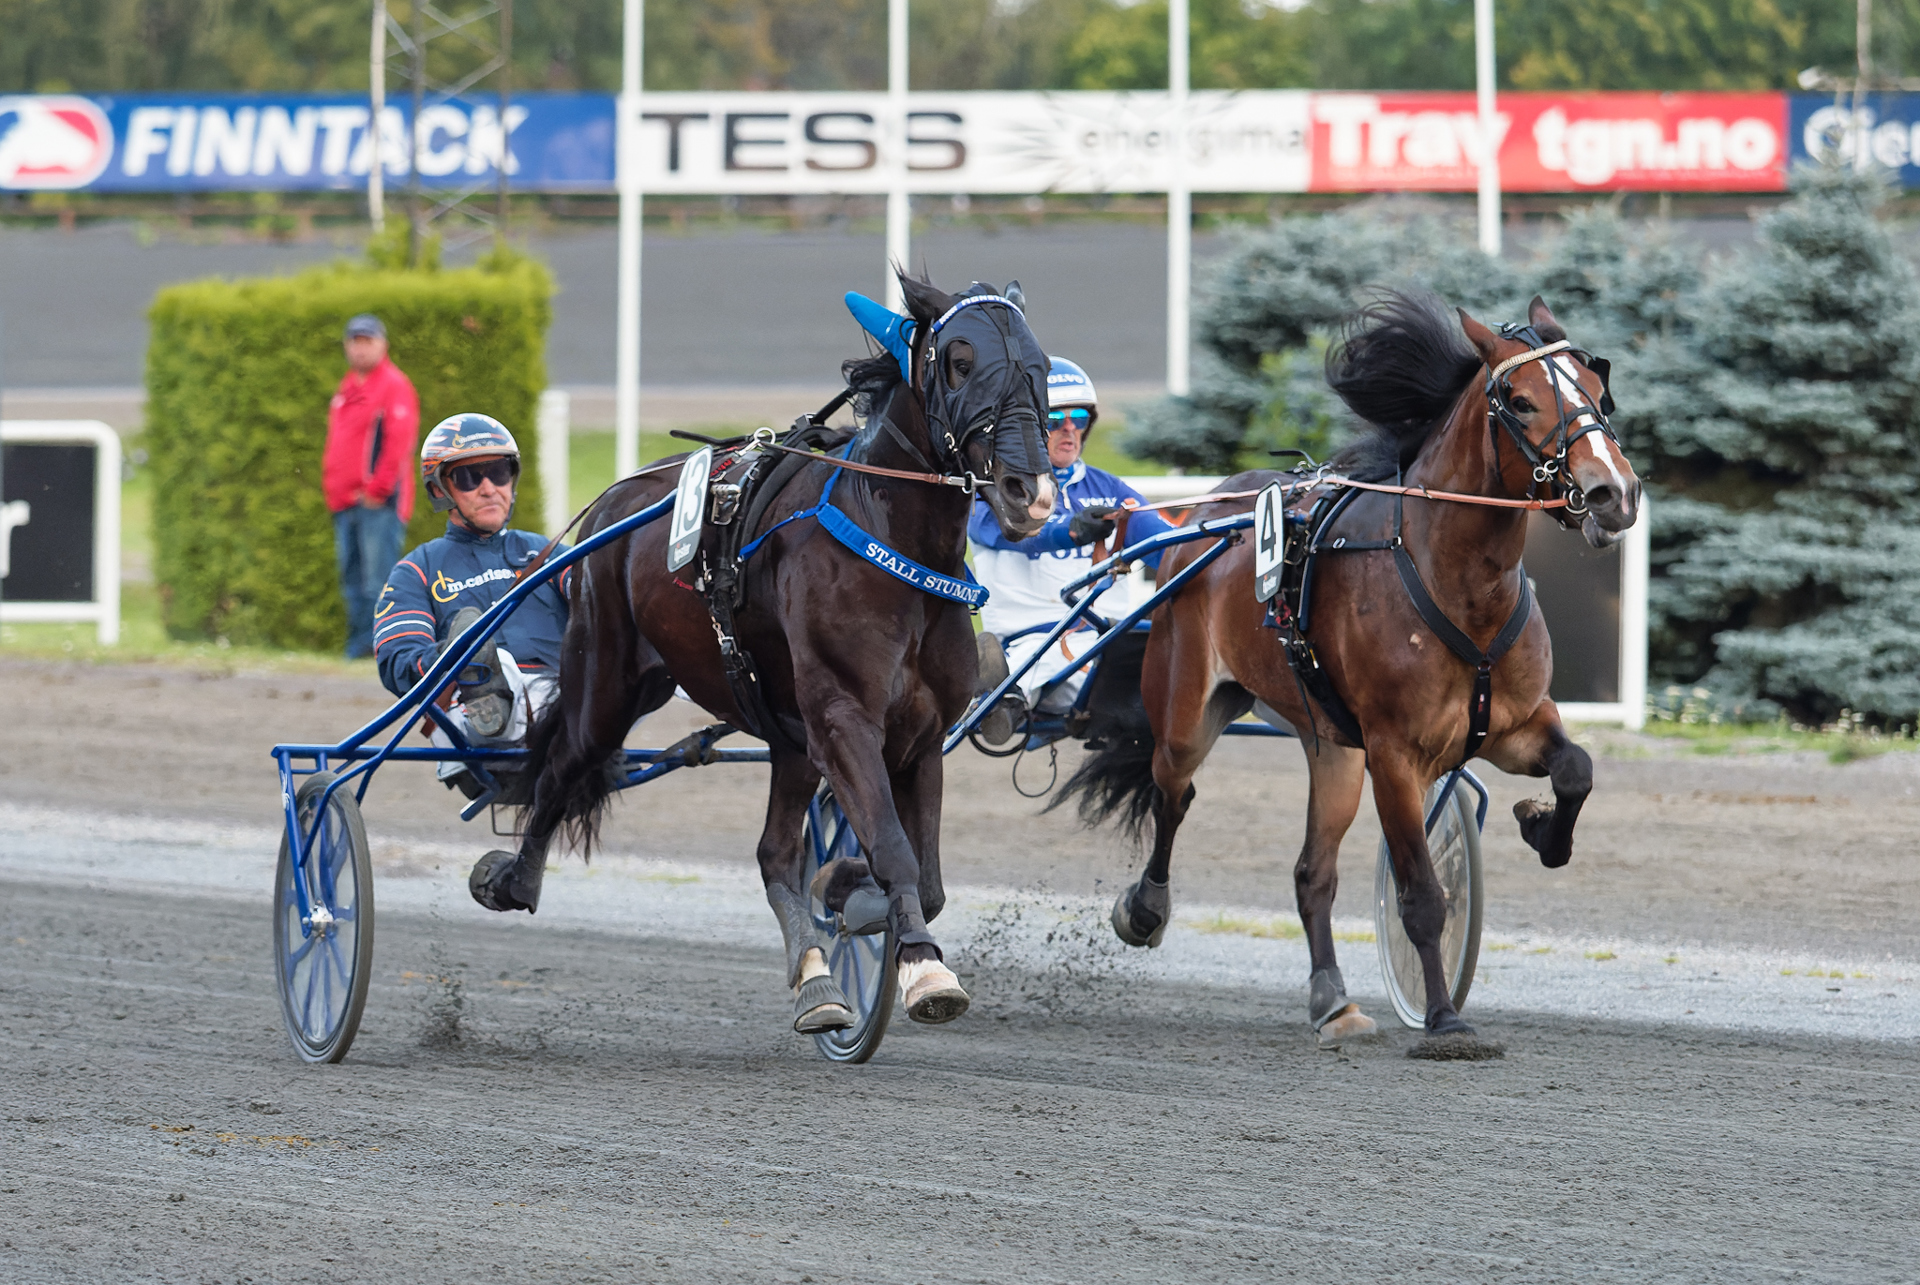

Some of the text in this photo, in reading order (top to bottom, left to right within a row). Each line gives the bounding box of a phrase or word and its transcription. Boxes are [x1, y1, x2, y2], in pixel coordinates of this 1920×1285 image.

[122, 106, 528, 177] FINNTACK
[641, 111, 967, 172] TESS
[1532, 105, 1777, 185] tgn.no
[1047, 374, 1084, 384] OLVO
[1260, 489, 1276, 562] 4
[865, 542, 920, 583] STALL
